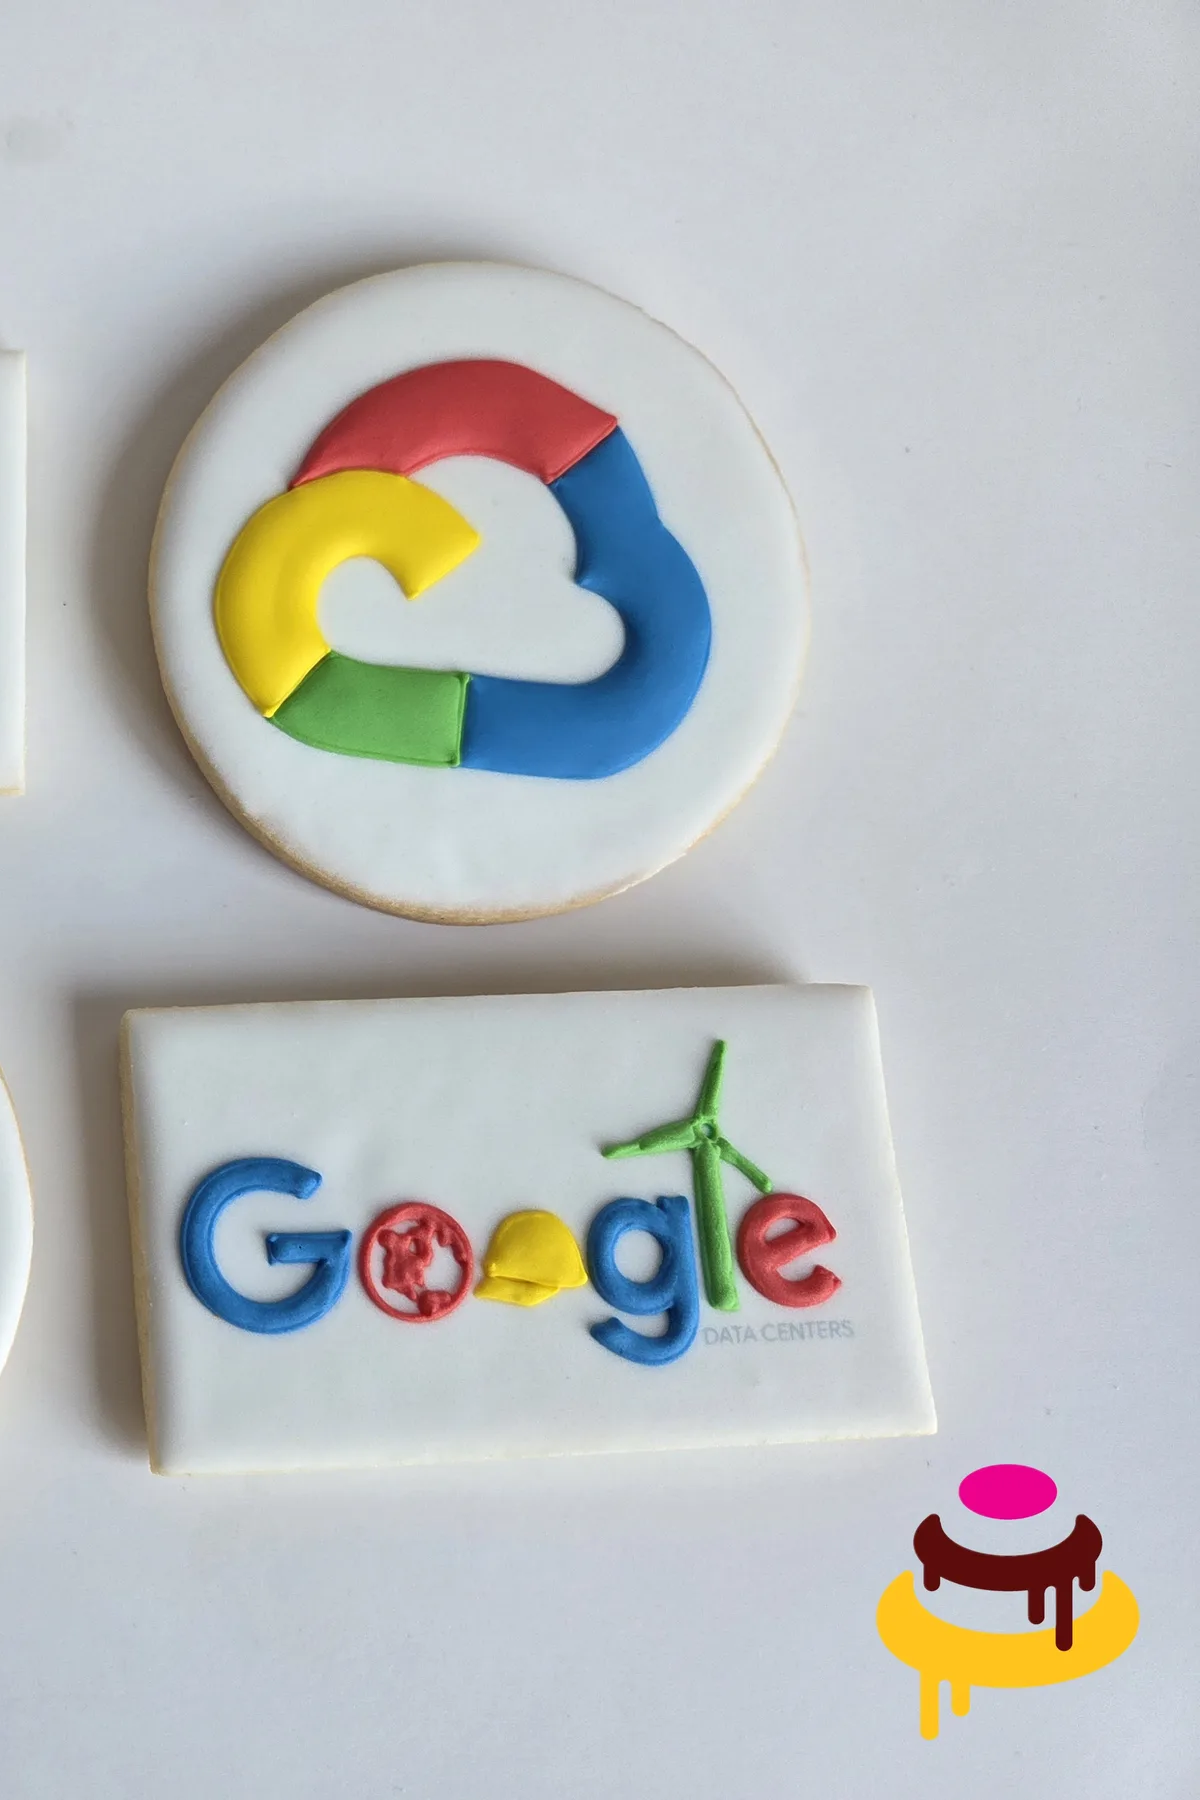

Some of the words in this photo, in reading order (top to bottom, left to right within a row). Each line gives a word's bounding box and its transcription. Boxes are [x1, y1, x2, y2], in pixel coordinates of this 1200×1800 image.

[179, 1040, 842, 1366] Google
[703, 1325, 757, 1345] DATA
[761, 1320, 855, 1342] CENTERS
